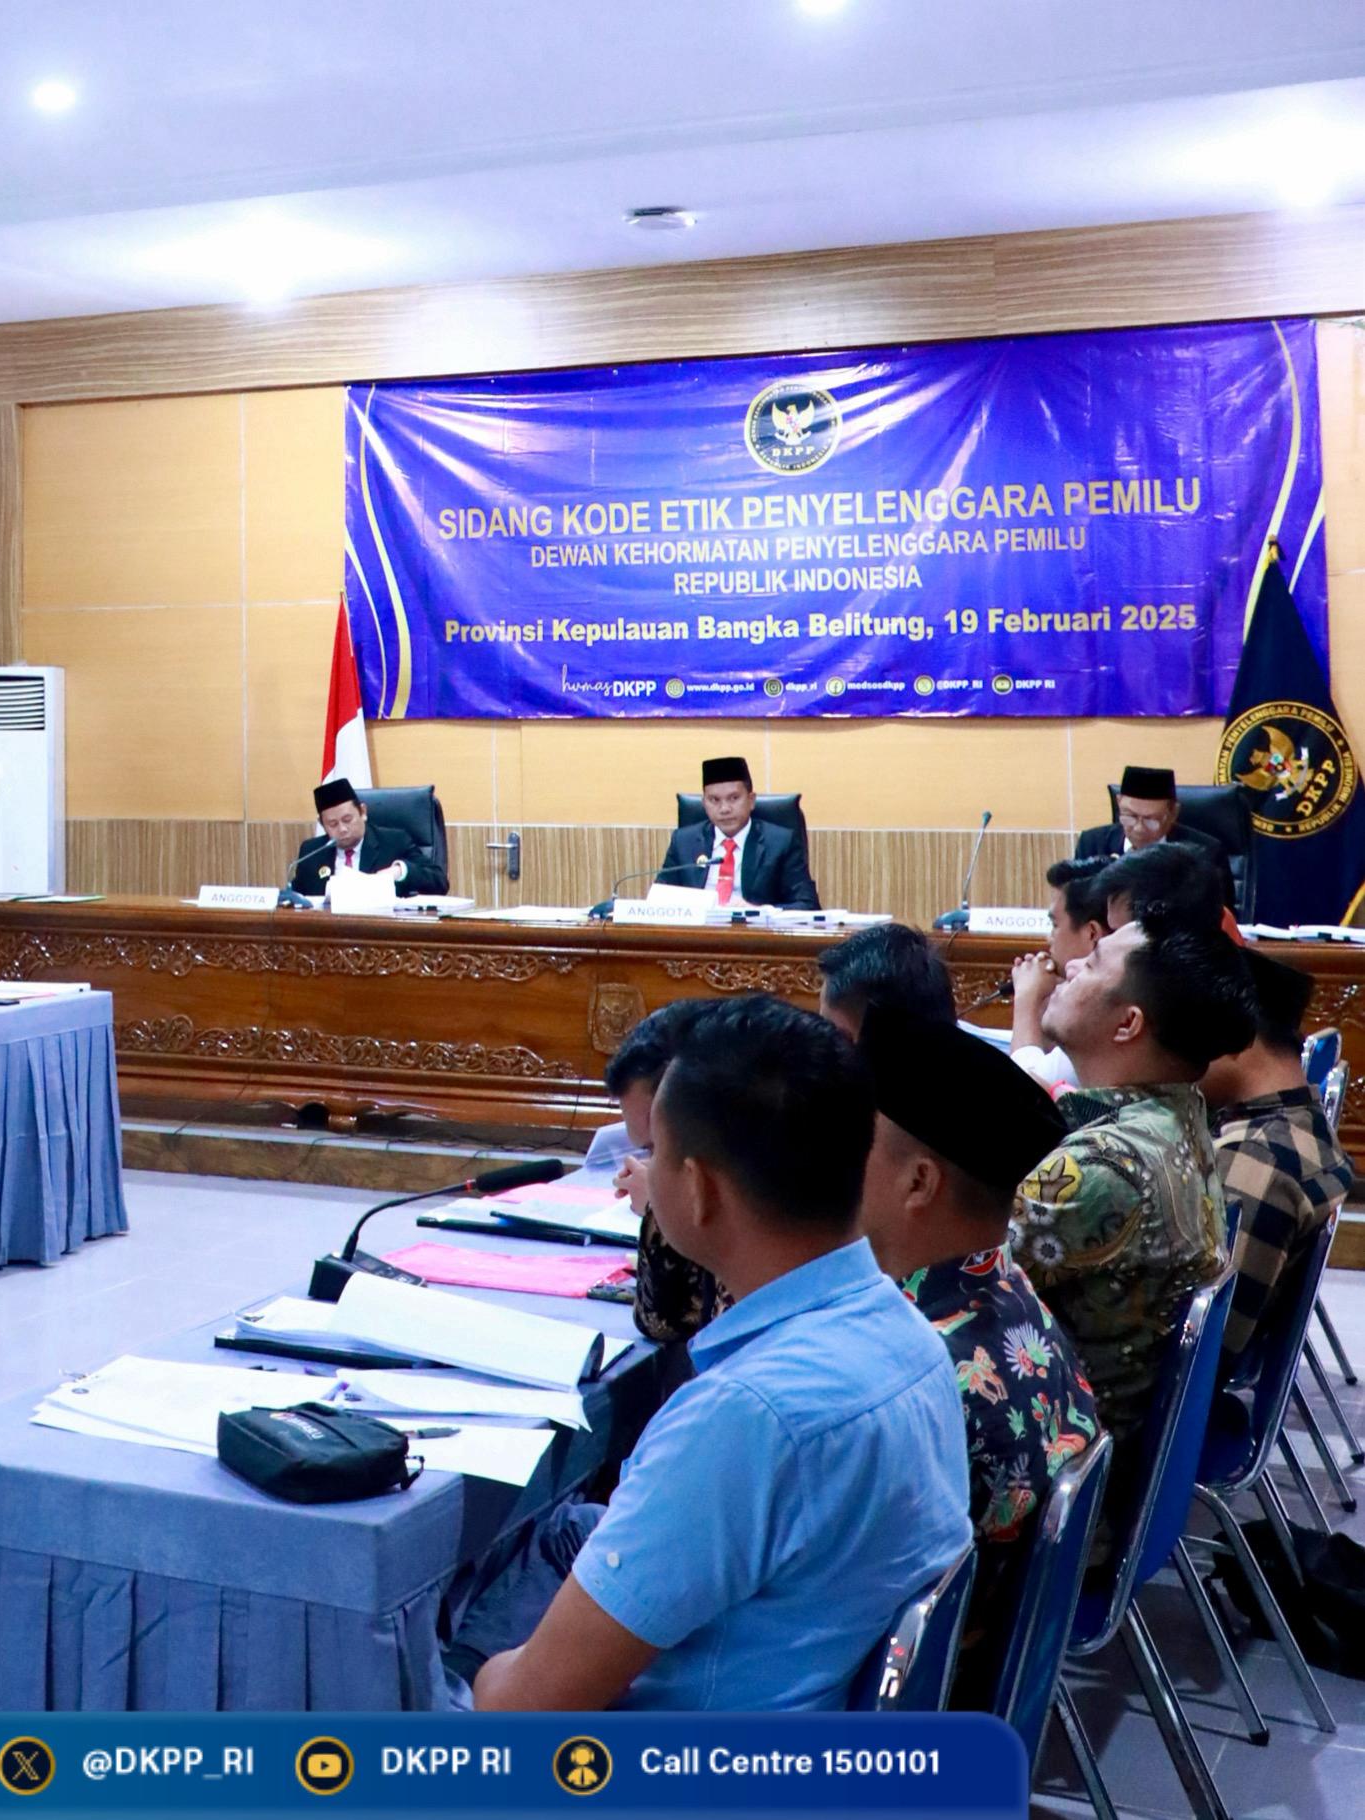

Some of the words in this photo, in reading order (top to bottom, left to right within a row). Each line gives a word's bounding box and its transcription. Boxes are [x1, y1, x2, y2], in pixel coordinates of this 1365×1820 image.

[771, 446, 815, 457] DKPP
[438, 504, 552, 540] SIDANG
[562, 501, 650, 535] KODE
[660, 497, 733, 532] ETIK
[742, 482, 1055, 529] PENYELENGGARA
[1063, 477, 1202, 516] PEMILU
[530, 544, 608, 568] DEWAN
[614, 539, 771, 566] KEHORMATAN
[775, 530, 989, 561] PENYELENGGARA
[994, 527, 1087, 552] PEMILU
[674, 569, 790, 596] REPUBLIK
[794, 565, 923, 593] INDONESIA
[445, 618, 544, 643] Provinsi
[552, 618, 689, 646] Kepulauan
[698, 615, 800, 646] Bangka
[809, 611, 935, 642] Belitung,
[943, 609, 979, 635] 19
[988, 605, 1111, 634] Februari
[1121, 604, 1197, 632] 2025
[613, 680, 657, 697] DKPP
[1015, 679, 1043, 690] DKPP
[1295, 759, 1336, 818] DKPP
[210, 893, 267, 905] ANGGOTA
[627, 906, 693, 918] ANGGOTA
[986, 915, 1052, 928] ANGGOT
